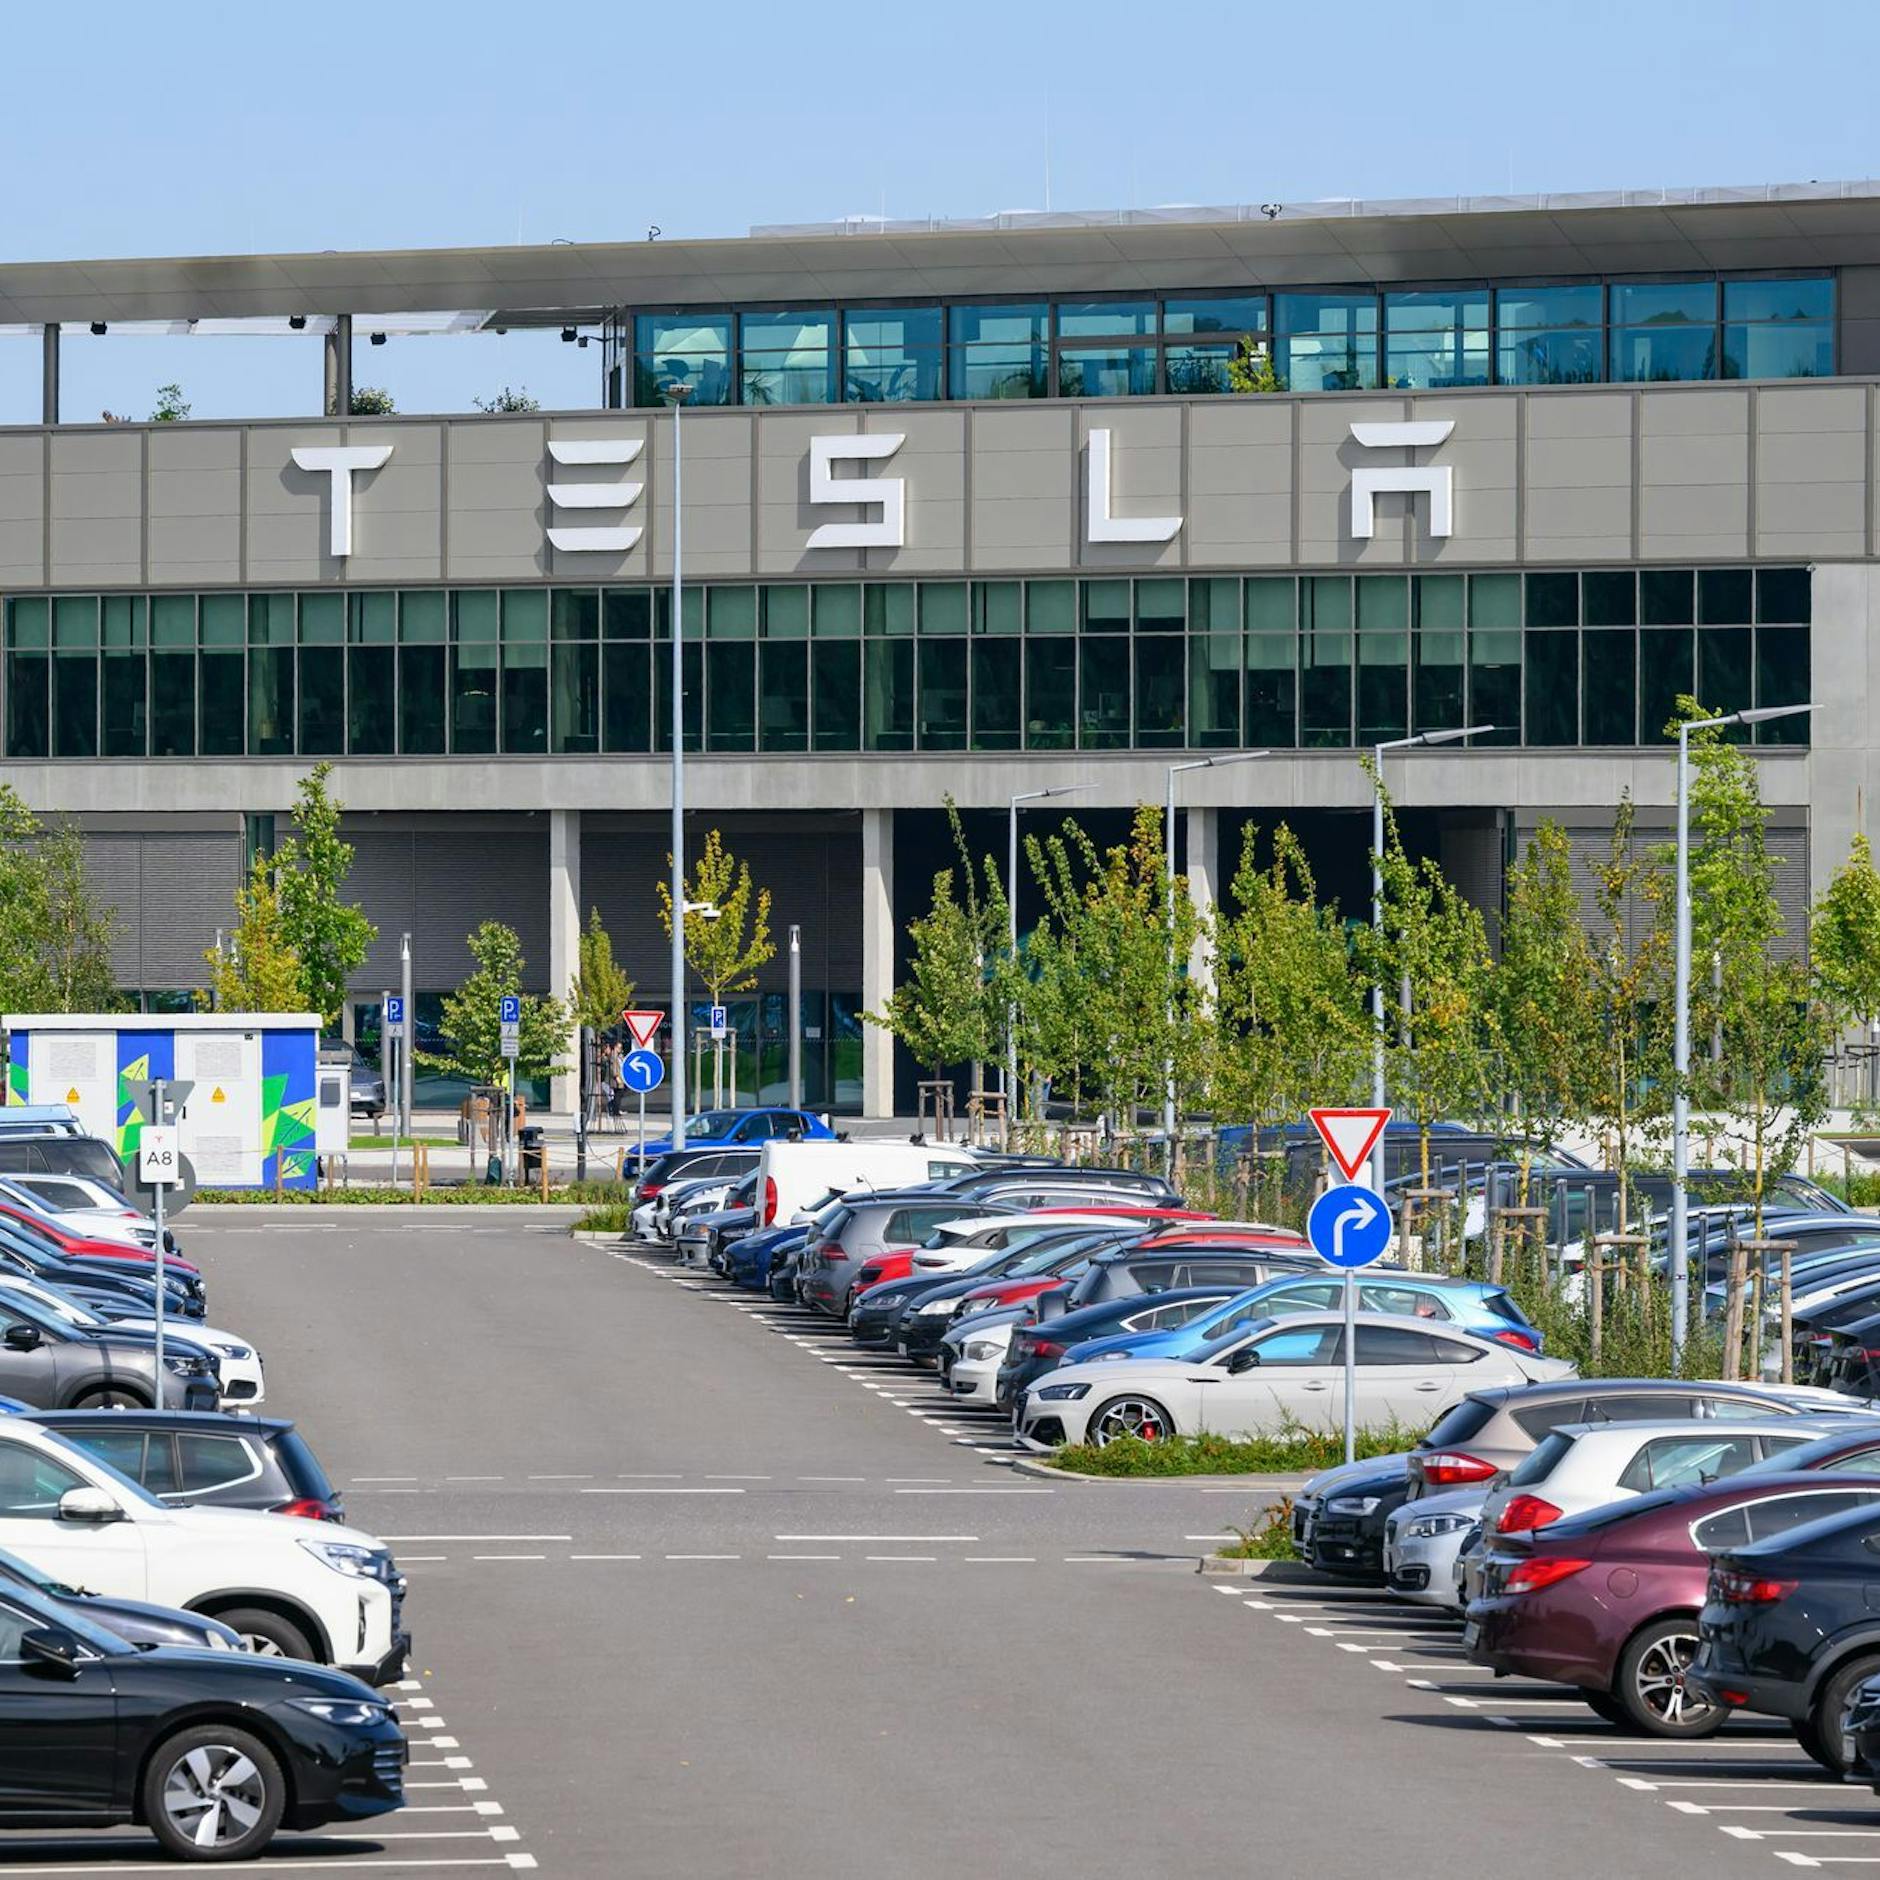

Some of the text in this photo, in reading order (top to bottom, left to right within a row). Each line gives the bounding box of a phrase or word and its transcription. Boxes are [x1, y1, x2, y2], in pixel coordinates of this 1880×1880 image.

[291, 421, 1456, 556] TESLA
[389, 1000, 400, 1020] P
[504, 1000, 515, 1021] P
[715, 1010, 723, 1022] P
[147, 1151, 172, 1166] A8
